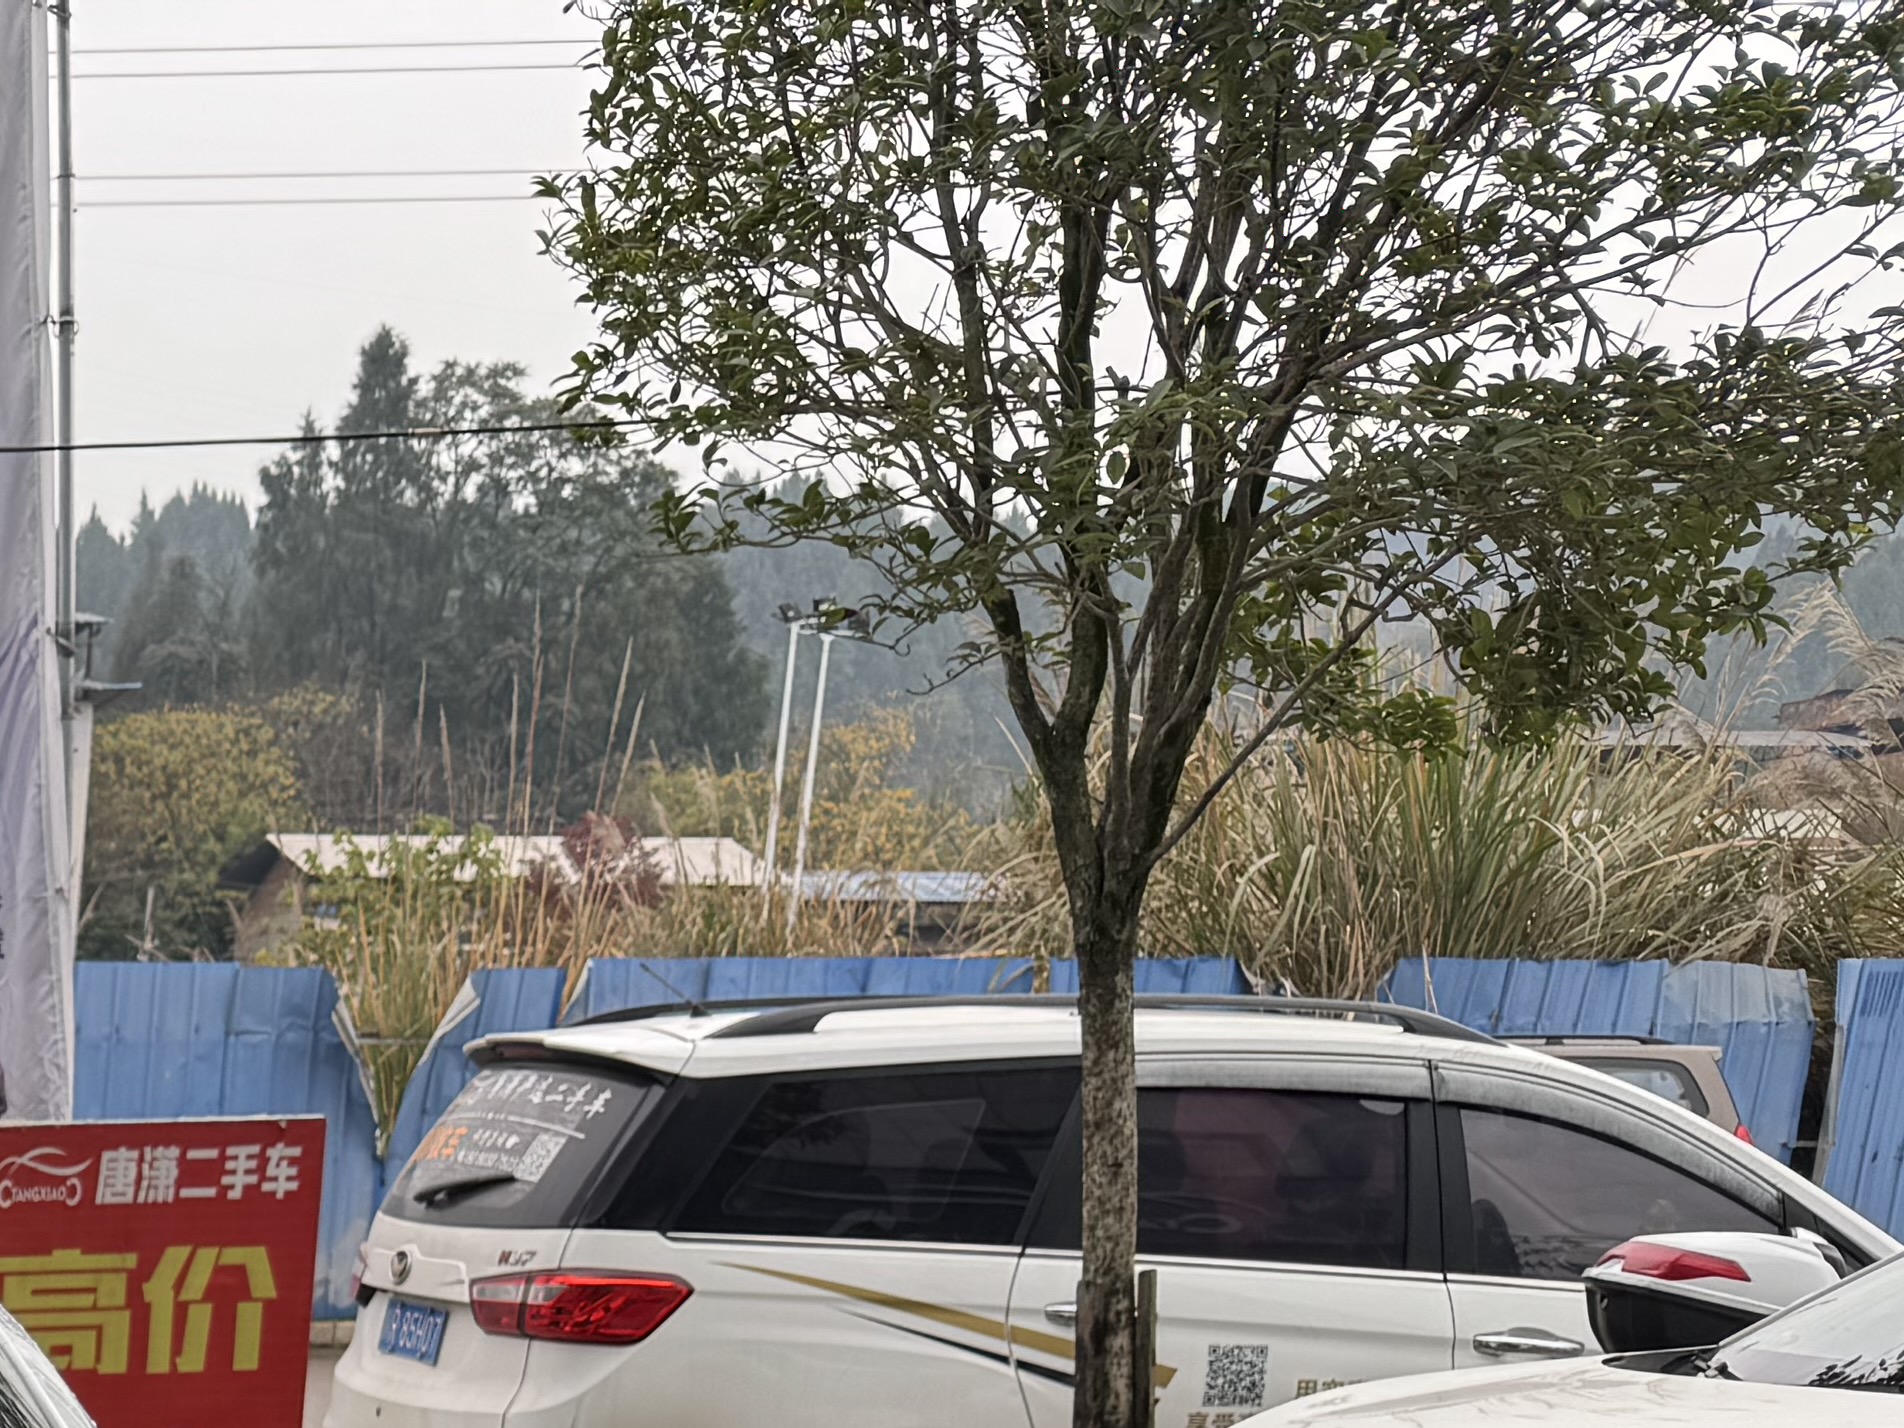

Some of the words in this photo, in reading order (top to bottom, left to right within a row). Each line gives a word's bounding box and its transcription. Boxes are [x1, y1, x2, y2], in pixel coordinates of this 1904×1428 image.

[95, 1144, 302, 1205] 唐潇二手车
